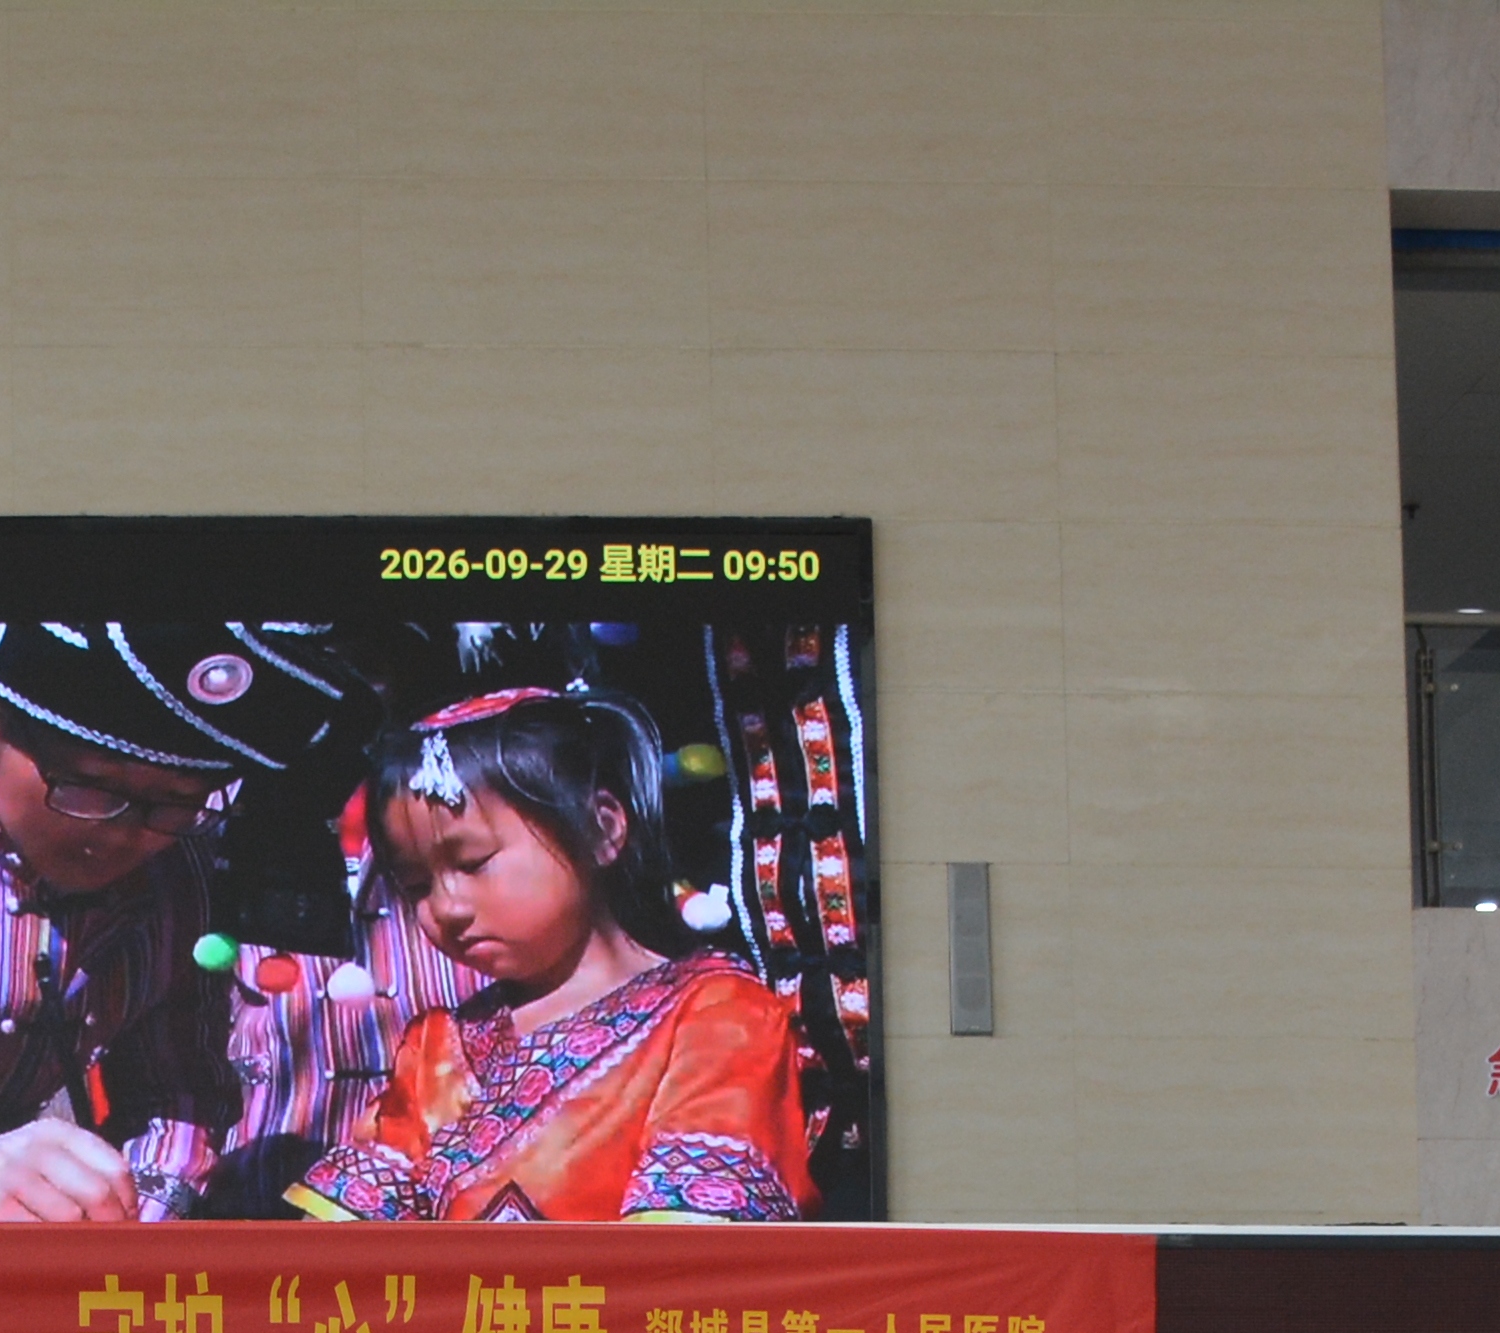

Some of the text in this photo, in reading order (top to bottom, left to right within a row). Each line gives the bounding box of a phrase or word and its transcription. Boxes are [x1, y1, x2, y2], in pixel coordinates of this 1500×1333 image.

[381, 547, 819, 583] 2026-09-29 星期二 09:50
